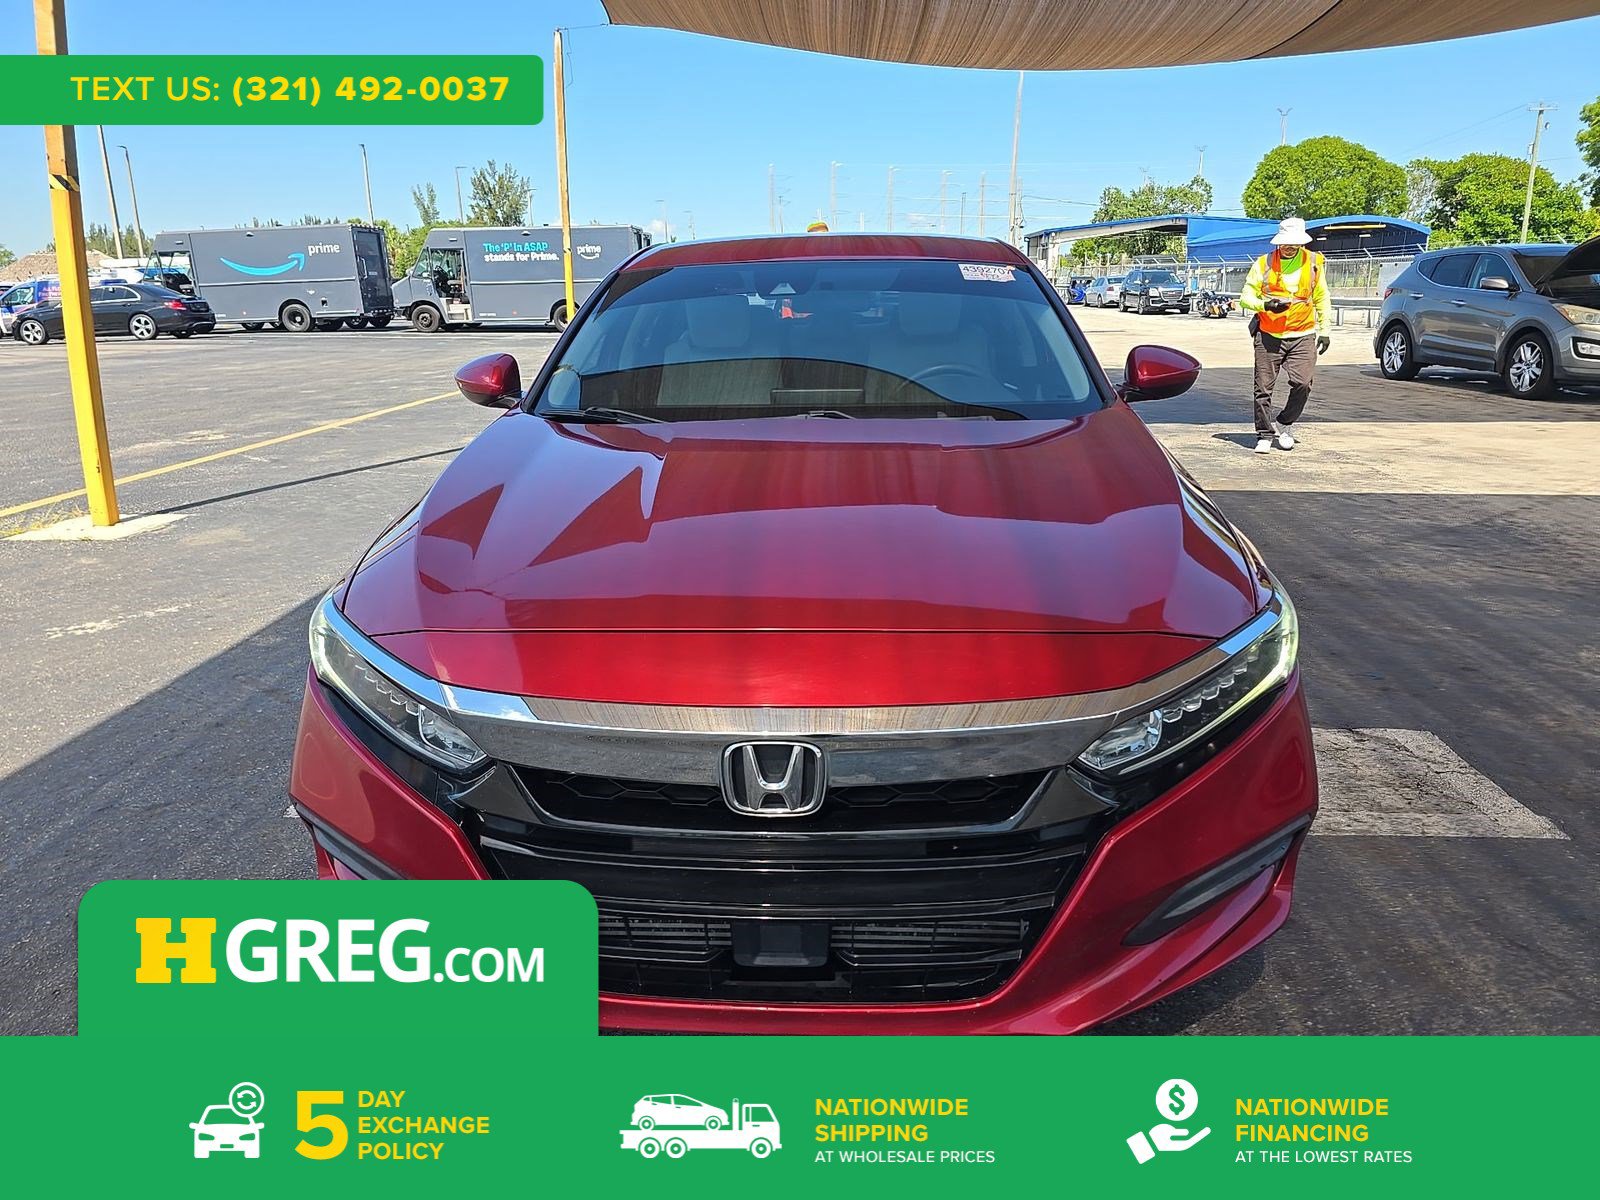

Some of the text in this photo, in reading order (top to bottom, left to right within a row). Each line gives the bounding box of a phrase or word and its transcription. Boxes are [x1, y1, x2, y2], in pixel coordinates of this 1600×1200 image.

[308, 242, 340, 256] prime
[483, 243, 500, 252] The
[524, 242, 548, 252] ASAP
[576, 244, 601, 255] prime
[484, 253, 515, 262] stands
[516, 252, 530, 262] for
